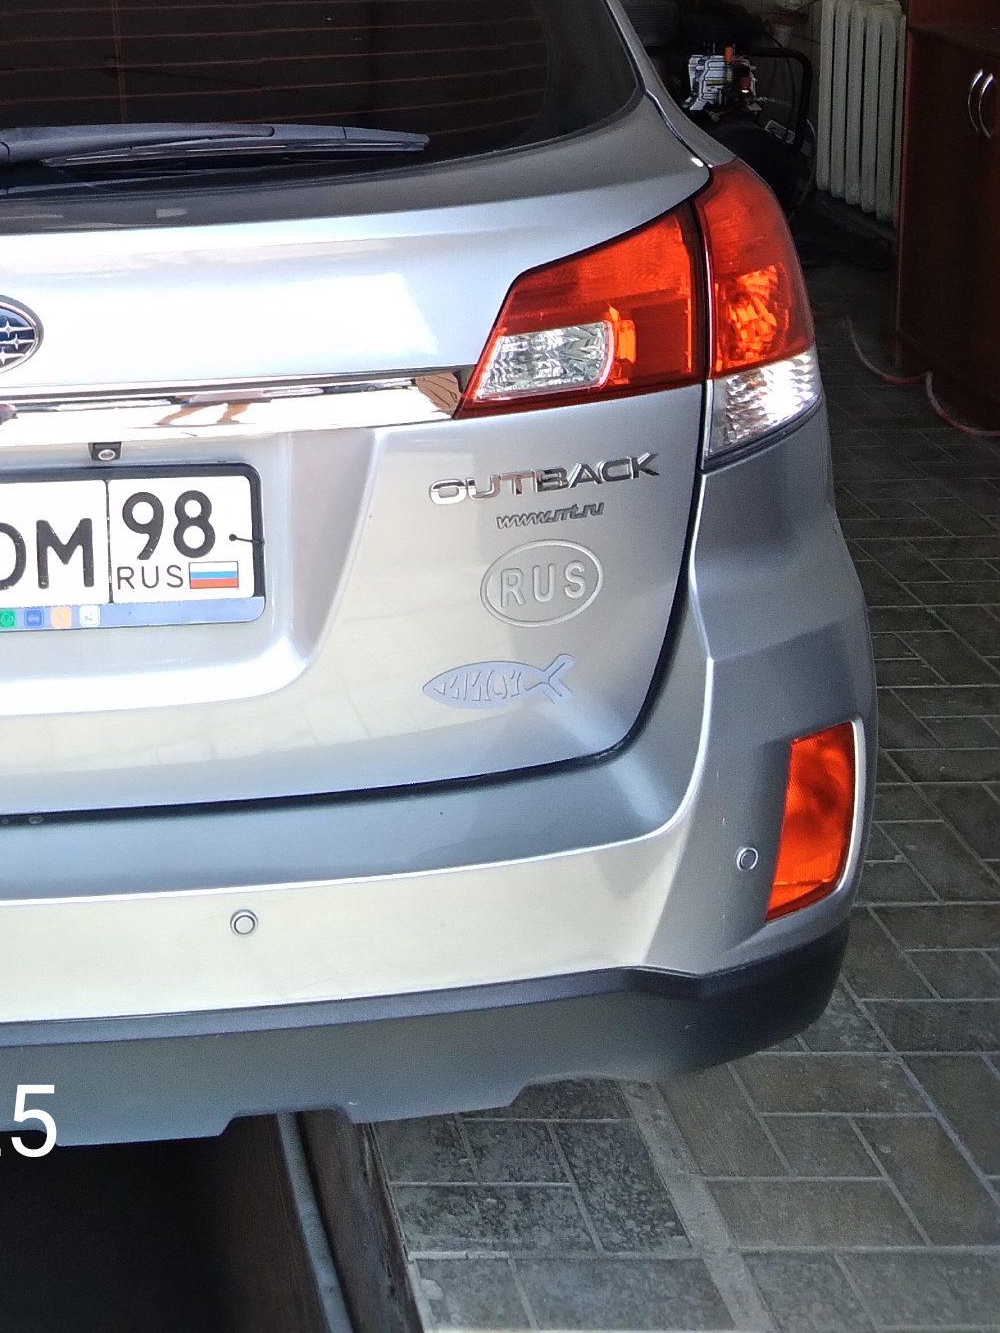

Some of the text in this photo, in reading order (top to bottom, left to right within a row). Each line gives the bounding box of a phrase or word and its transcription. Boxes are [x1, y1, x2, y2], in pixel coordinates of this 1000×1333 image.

[429, 452, 659, 505] OUTBACK
[121, 490, 216, 560] 98
[116, 564, 184, 590] RUS
[499, 560, 588, 607] RUS
